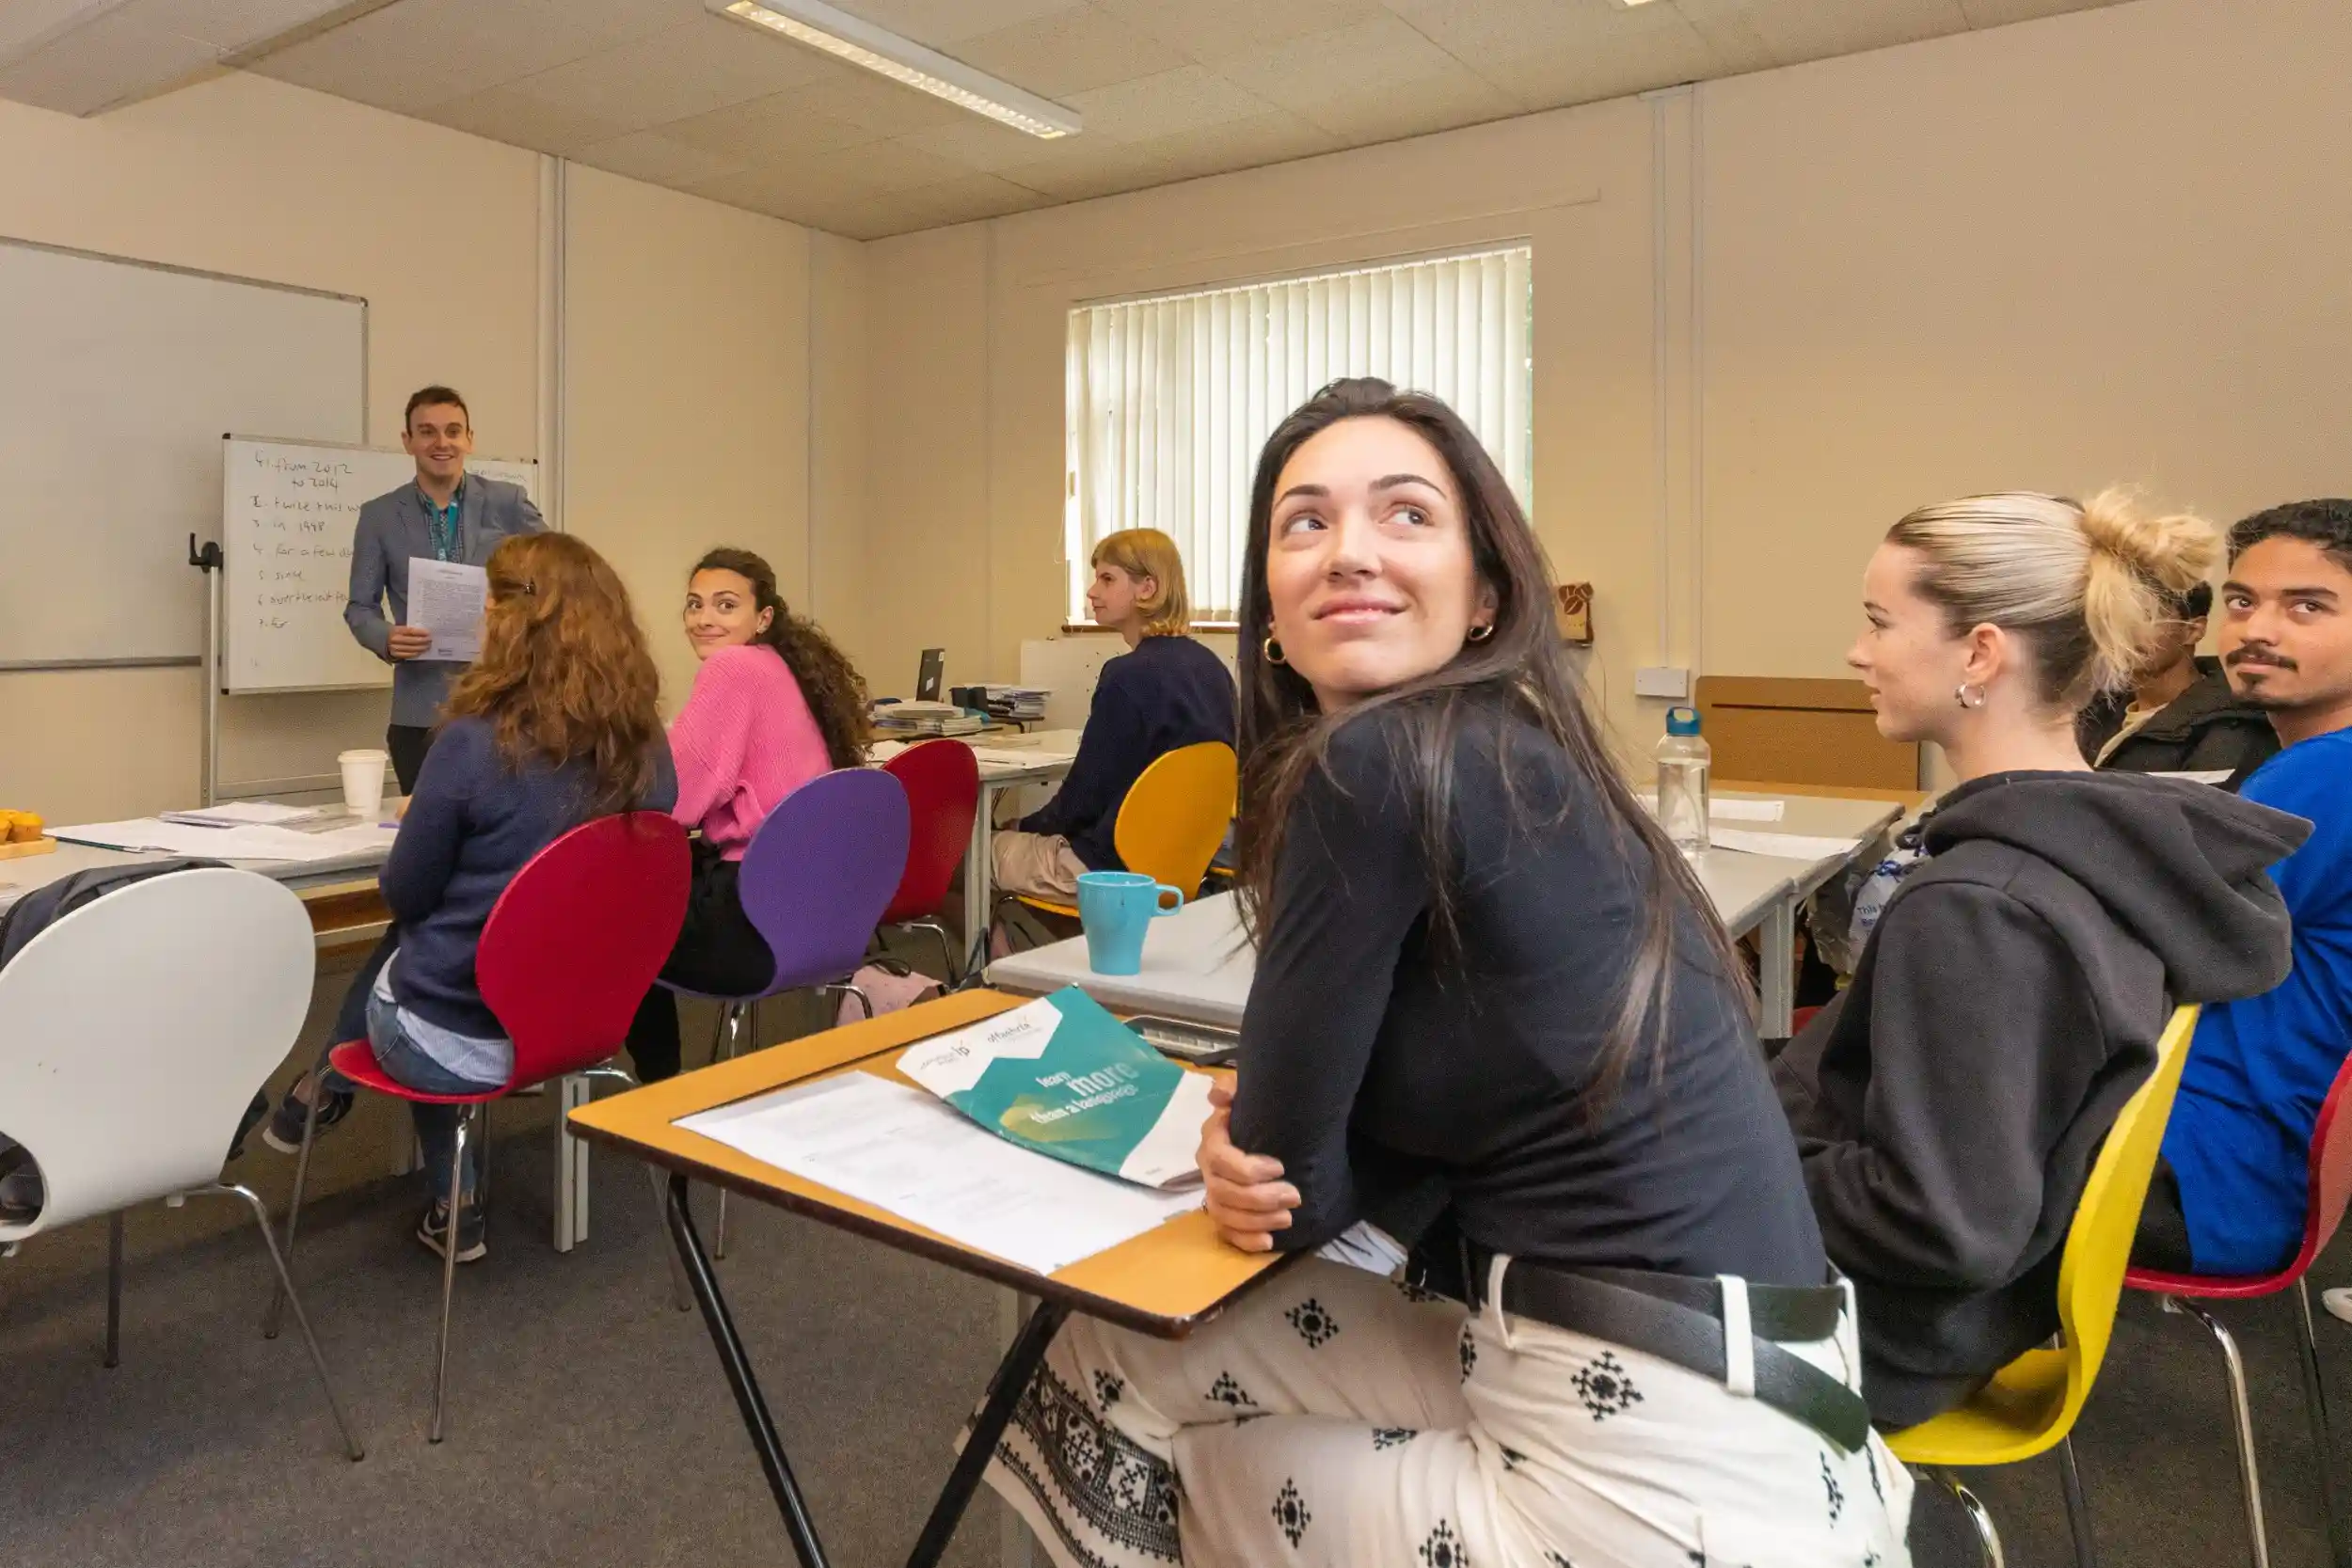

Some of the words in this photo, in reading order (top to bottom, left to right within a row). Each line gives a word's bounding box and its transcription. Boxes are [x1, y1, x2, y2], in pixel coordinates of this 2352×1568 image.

[275, 456, 308, 473] from
[311, 461, 354, 475] 2012
[292, 476, 305, 490] to
[309, 477, 338, 494] 2014
[1035, 1070, 1073, 1088] learn
[1066, 1062, 1140, 1097] more
[1029, 1108, 1071, 1124] than
[1065, 1104, 1081, 1114] a
